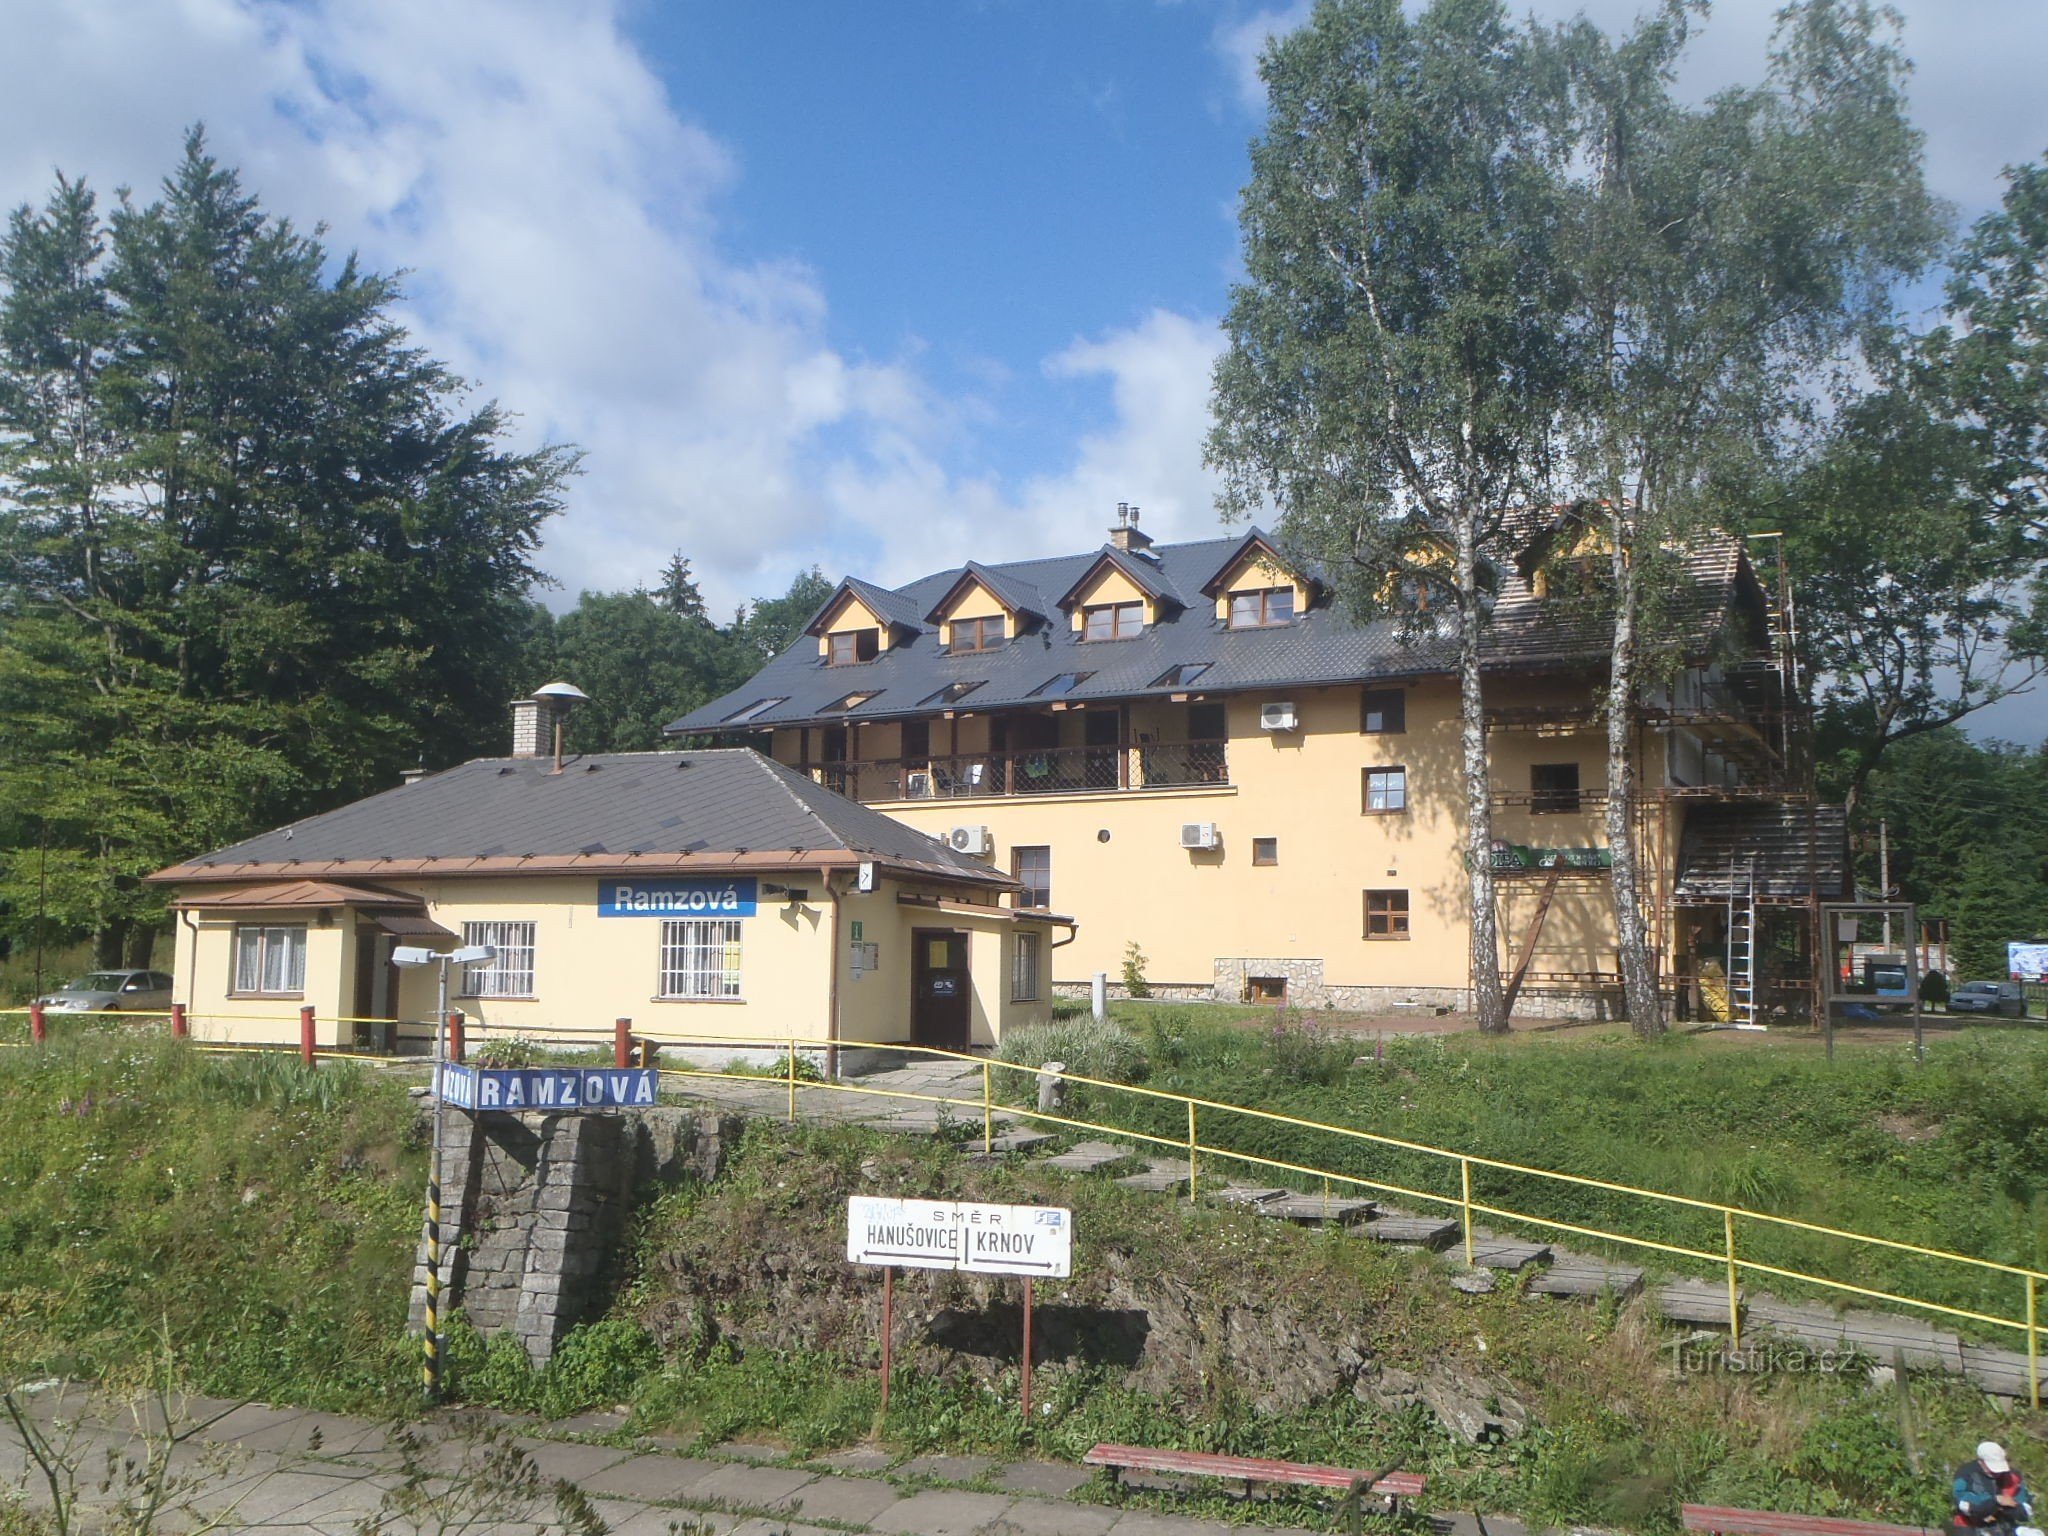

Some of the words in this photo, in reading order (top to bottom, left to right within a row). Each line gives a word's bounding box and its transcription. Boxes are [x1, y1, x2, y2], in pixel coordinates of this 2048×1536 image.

[615, 884, 738, 911] Ramzová
[481, 1070, 653, 1106] RAMZOVÁ
[933, 1210, 1002, 1225] SMĚR
[867, 1222, 957, 1250] HANUŠOVICE
[977, 1231, 1035, 1254] KRNOV
